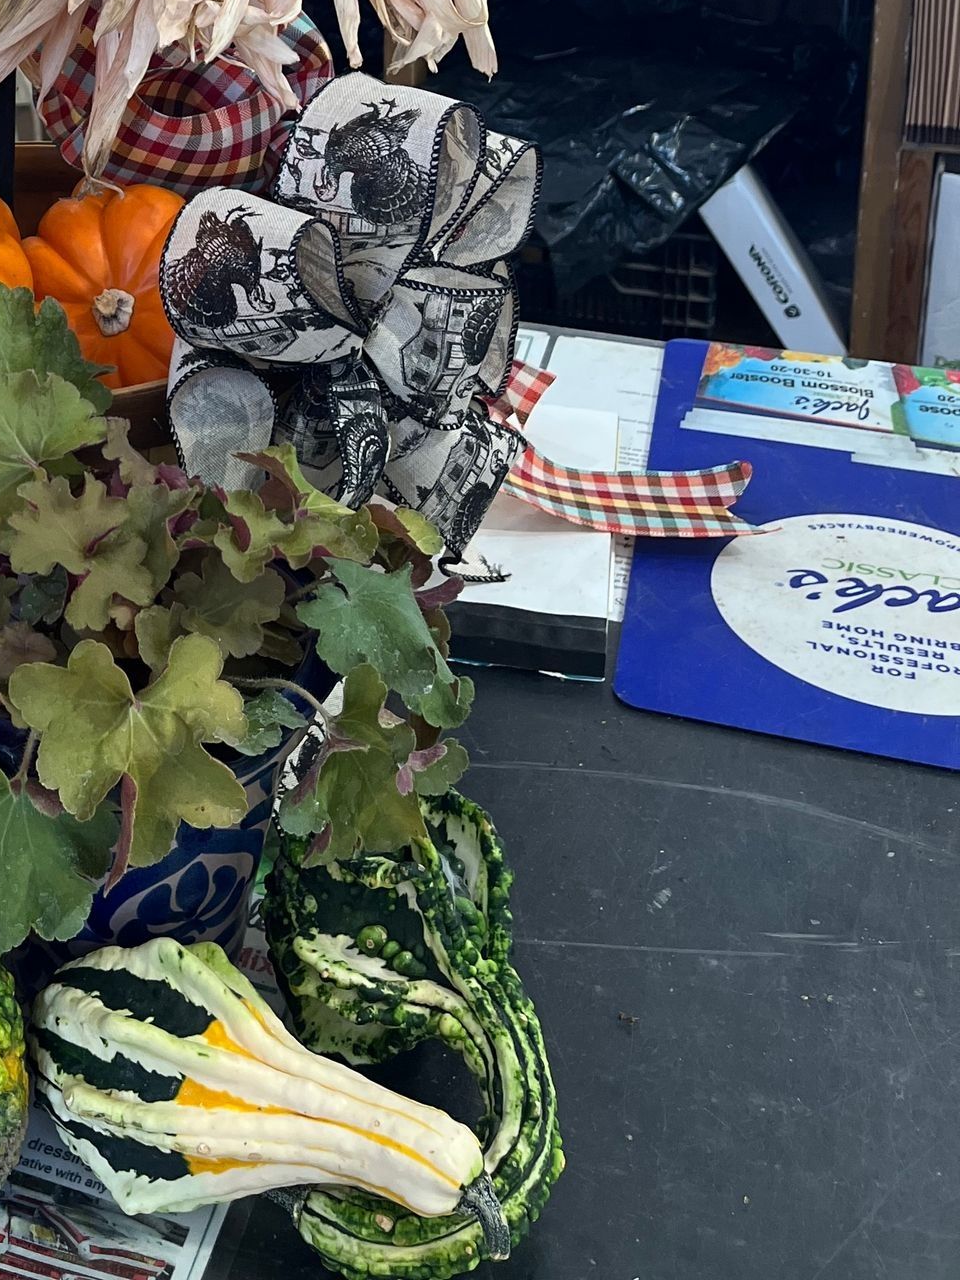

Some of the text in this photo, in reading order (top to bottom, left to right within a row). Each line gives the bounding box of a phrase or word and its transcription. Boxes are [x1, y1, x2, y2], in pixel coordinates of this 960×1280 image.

[749, 244, 790, 304] CORONA
[730, 372, 795, 388] Booster
[770, 364, 832, 378] 10-30-20
[801, 380, 874, 398] Blossom
[795, 396, 870, 420] Jack's
[820, 557, 960, 589] CLASSIC
[821, 620, 884, 638] HOME
[840, 633, 944, 660] RESULTS,
[871, 664, 916, 680] FOR
[55, 1166, 82, 1185] with
[84, 1178, 108, 1194] any
